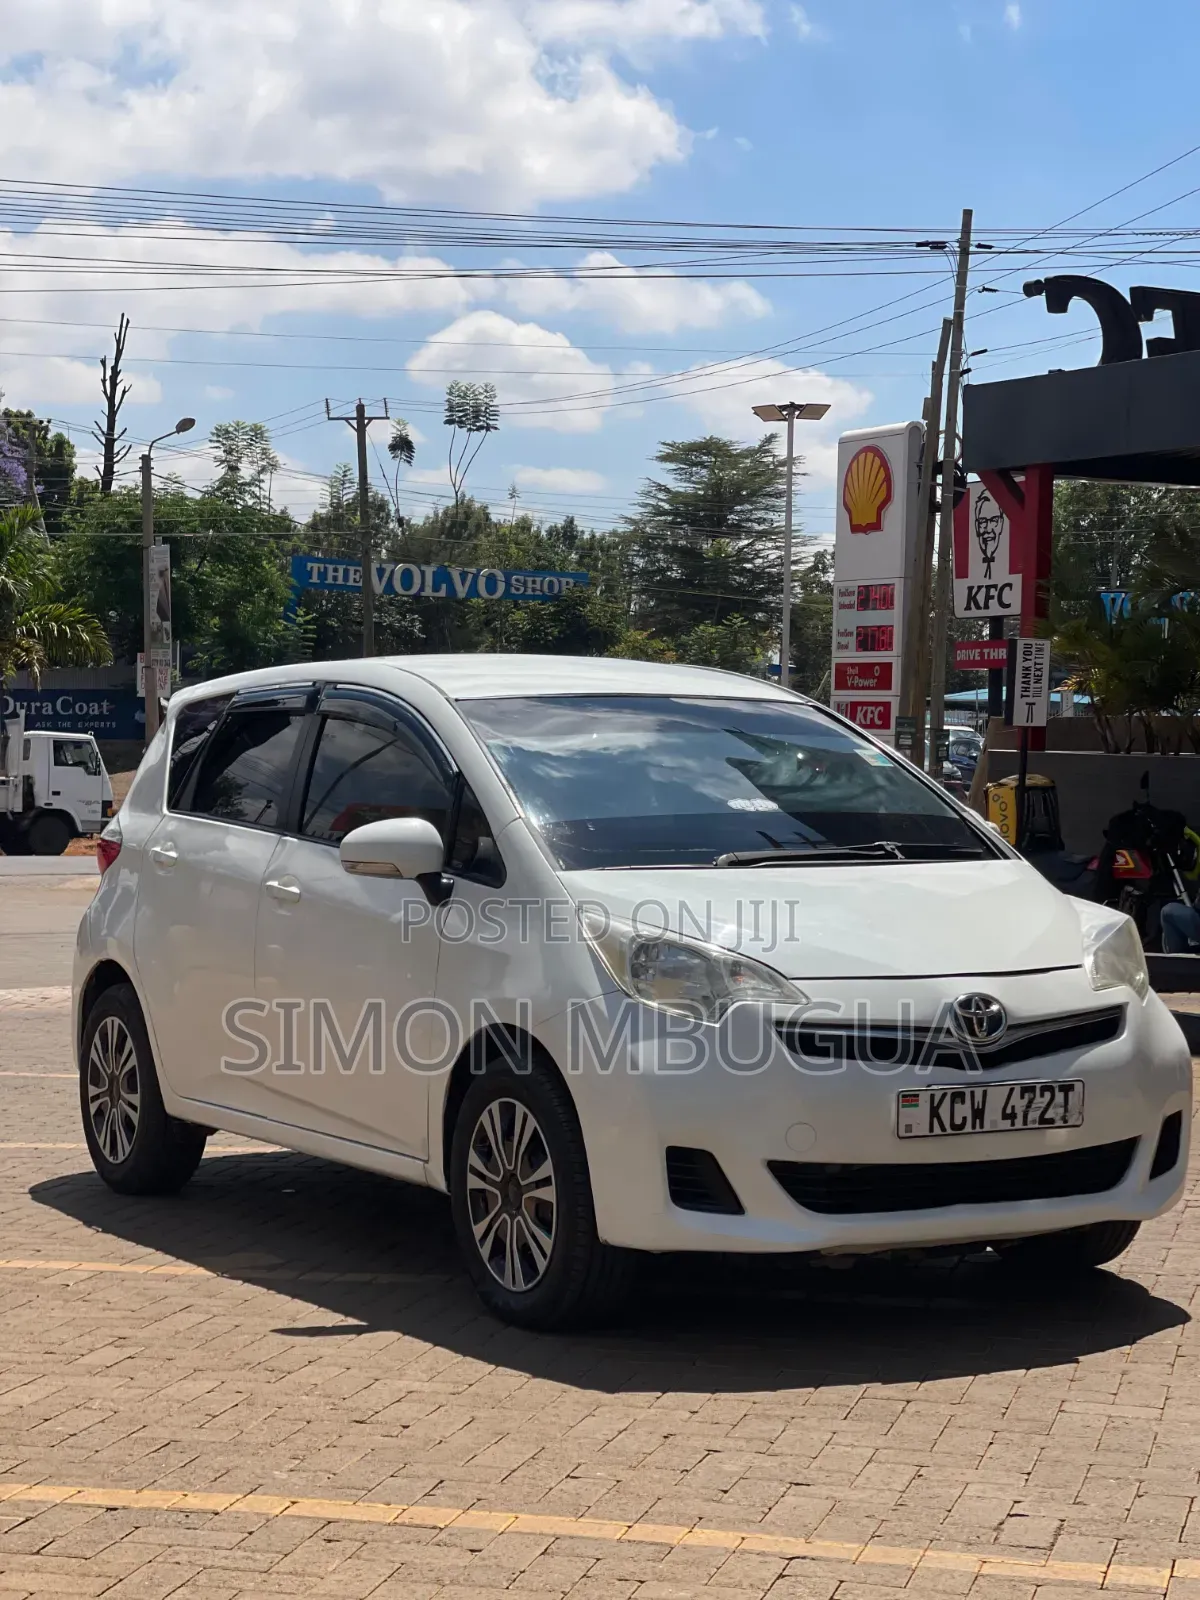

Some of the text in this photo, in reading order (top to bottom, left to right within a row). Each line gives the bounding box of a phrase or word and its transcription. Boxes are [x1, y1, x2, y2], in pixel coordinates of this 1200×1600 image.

[306, 562, 575, 600] THE VOLVO SHOP
[963, 582, 1013, 612] KFC
[956, 647, 1007, 661] DRIVE THR
[846, 666, 859, 675] Shell
[846, 675, 878, 687] V-Power
[1020, 642, 1034, 699] THANK YOU
[1032, 642, 1045, 698] TILL NEXT TIME
[77, 721, 117, 729] EXPERTS
[855, 705, 884, 725] KFC
[928, 1083, 1075, 1134] KCW 472T
